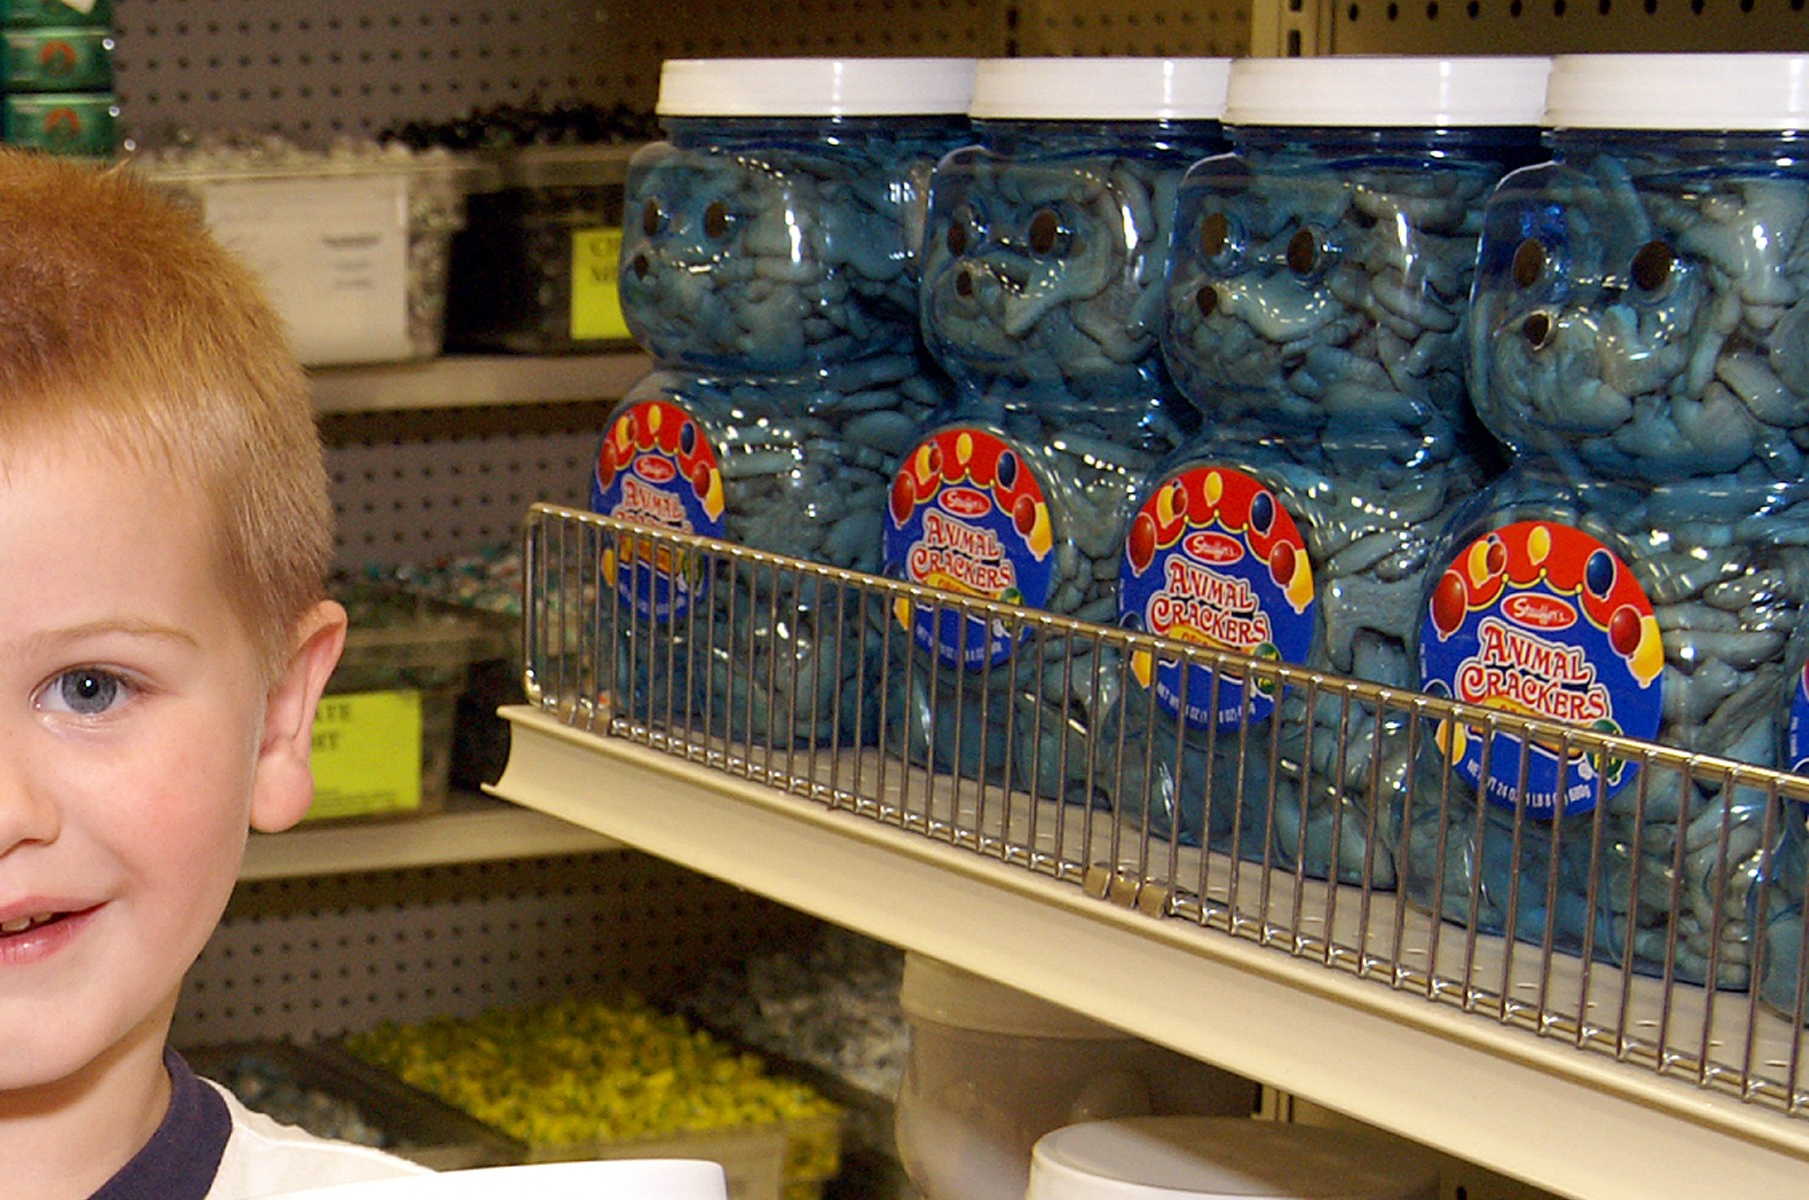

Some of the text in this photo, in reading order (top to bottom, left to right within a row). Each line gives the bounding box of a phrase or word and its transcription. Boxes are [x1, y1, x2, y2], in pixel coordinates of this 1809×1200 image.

[926, 515, 1001, 558] ANIMAL
[911, 548, 1013, 590] CRACKERS
[1168, 560, 1256, 612] ANIMAL
[1150, 597, 1268, 645] CRACKERS
[1482, 625, 1590, 683] ANIMAL
[1460, 665, 1607, 721] CRACKERS
